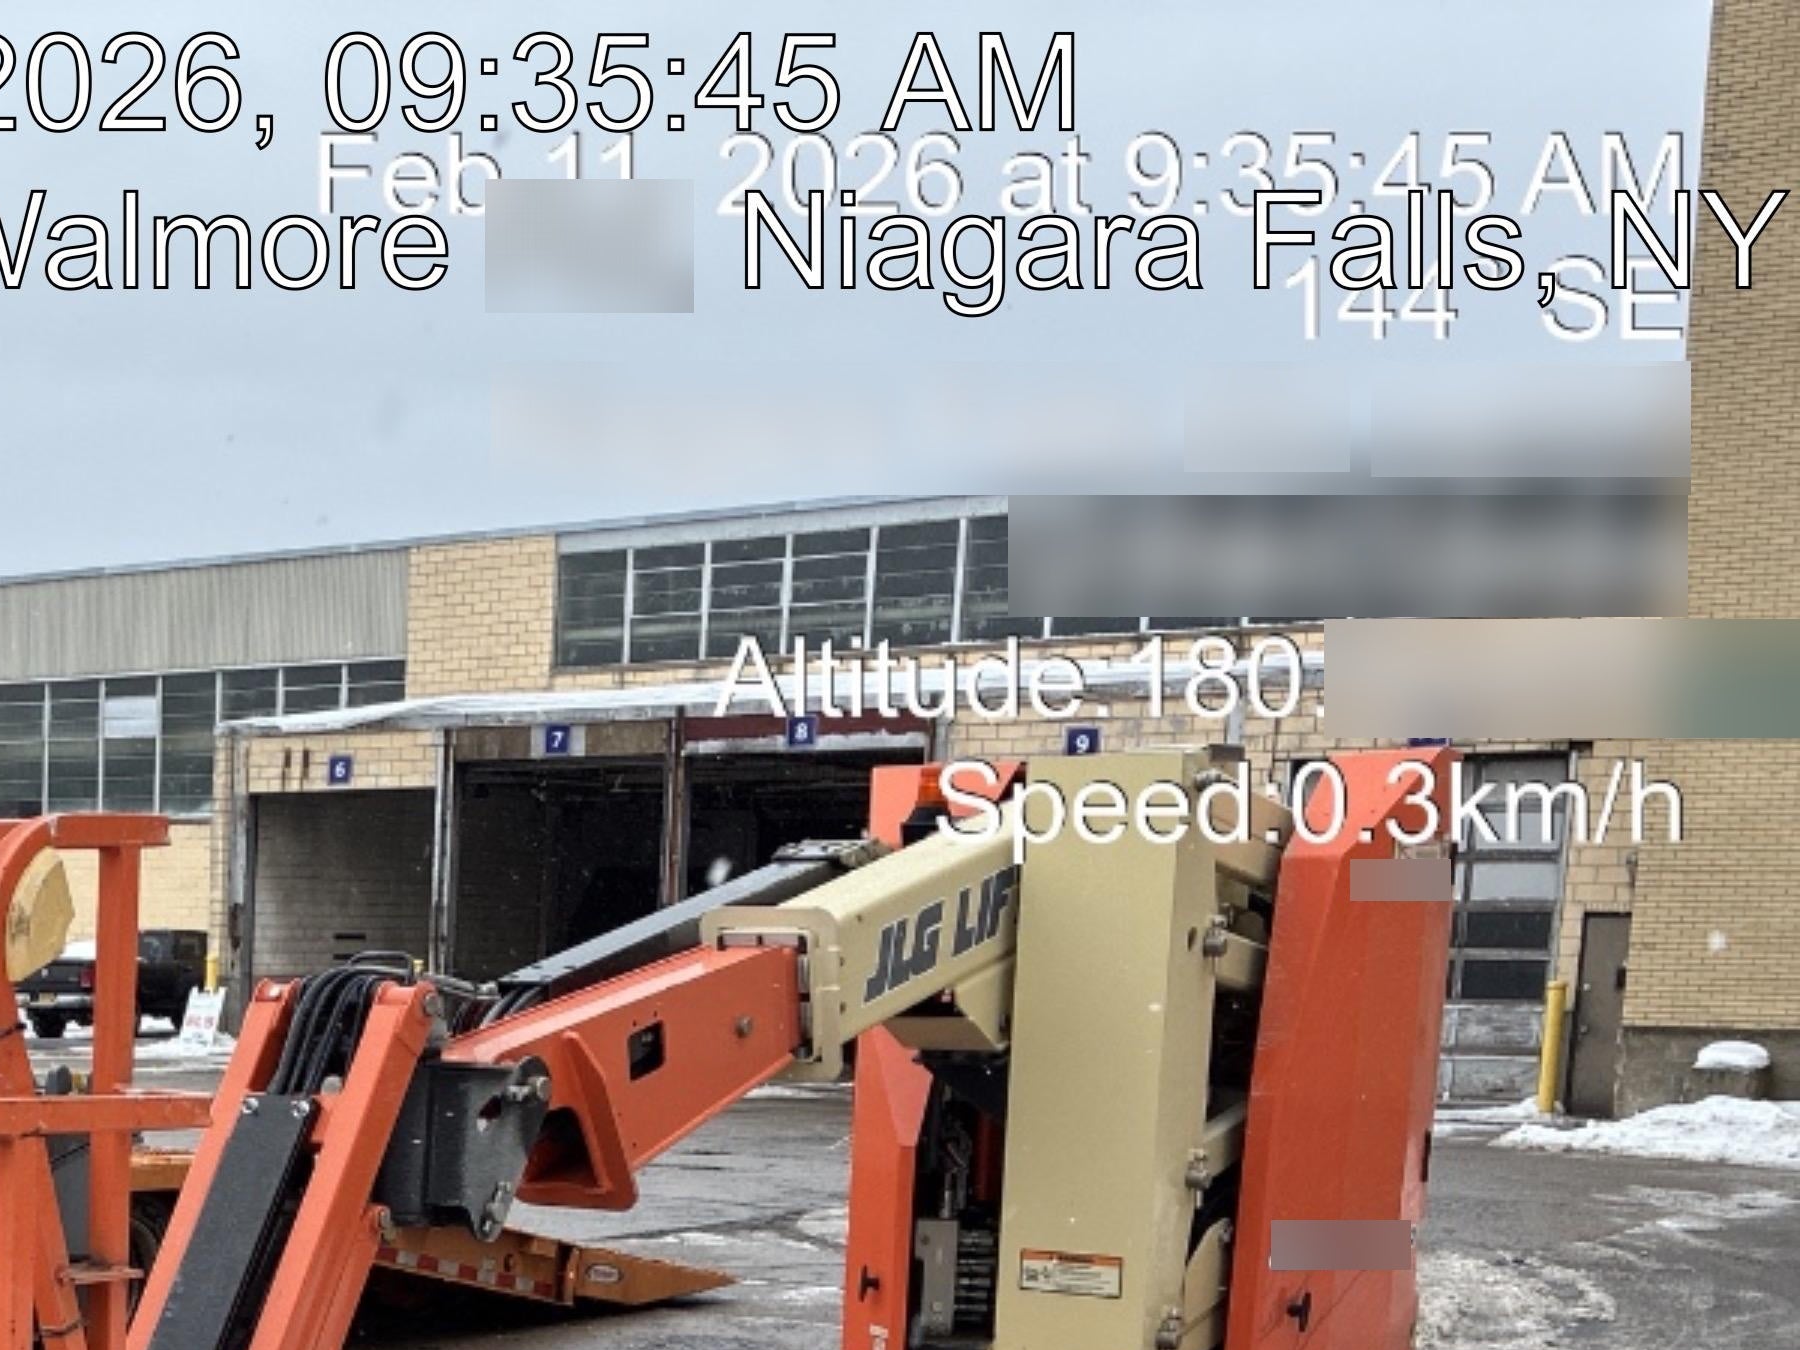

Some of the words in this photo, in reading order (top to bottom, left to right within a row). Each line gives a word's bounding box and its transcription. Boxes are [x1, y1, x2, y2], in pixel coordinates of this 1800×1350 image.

[551, 730, 565, 749] 7
[794, 721, 809, 741] 8
[1075, 734, 1090, 753] 9
[334, 760, 346, 778] 6
[862, 897, 946, 1007] JLG
